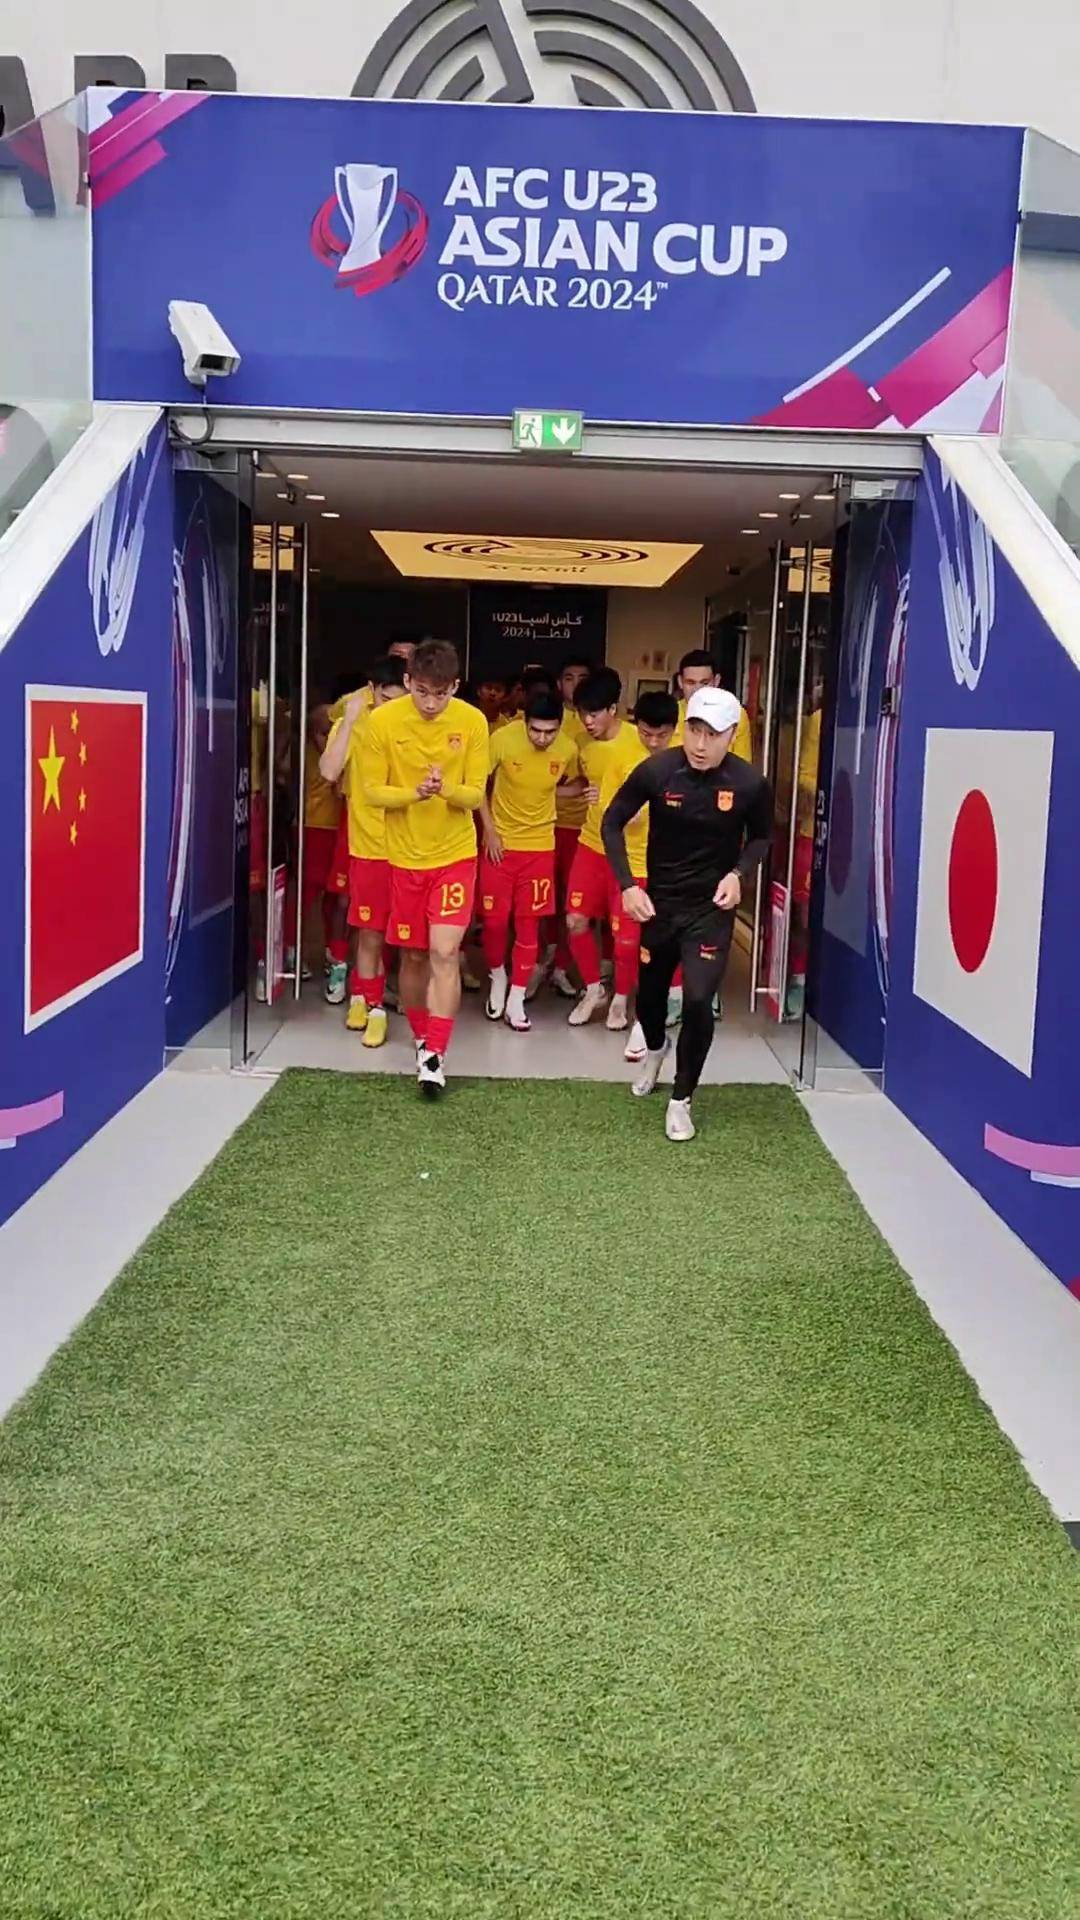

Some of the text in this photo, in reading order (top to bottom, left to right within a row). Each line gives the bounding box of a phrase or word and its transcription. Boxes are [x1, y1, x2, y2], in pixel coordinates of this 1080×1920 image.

[443, 165, 658, 213] AFC U23
[438, 214, 788, 277] ASIAN CUP
[437, 272, 559, 311] QATAR
[441, 882, 465, 909] 13
[531, 878, 551, 905] 17
